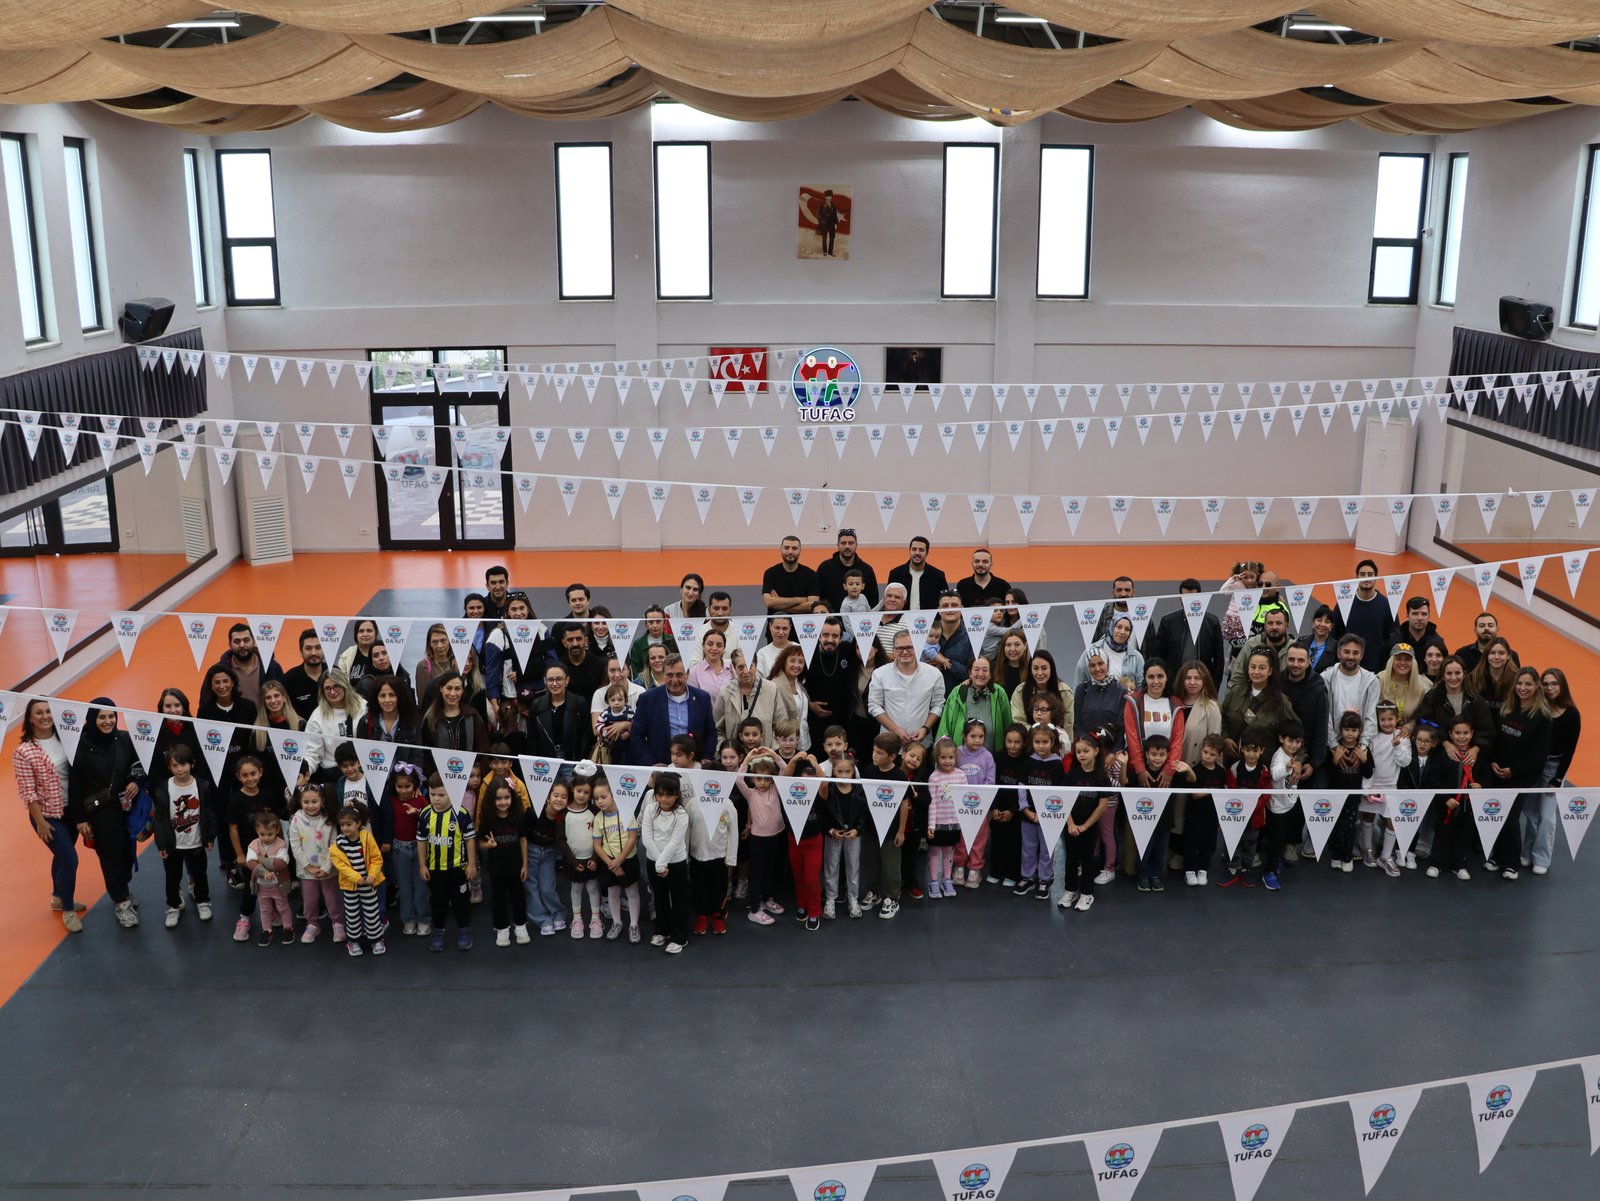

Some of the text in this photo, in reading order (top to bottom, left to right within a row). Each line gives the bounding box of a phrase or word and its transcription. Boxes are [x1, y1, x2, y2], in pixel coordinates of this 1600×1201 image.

[799, 407, 856, 422] TUFAG
[59, 725, 80, 733] TUFAG
[134, 734, 155, 743] TUFAG
[204, 744, 226, 753] TUFAG
[280, 754, 302, 762] TUFAG
[366, 764, 388, 772] TUFAG
[444, 772, 468, 780] TUFAG
[529, 774, 552, 783] TUFAG
[1478, 1108, 1514, 1122] TUFAG
[1361, 1127, 1398, 1142] TUFAG
[1234, 1148, 1273, 1163] TUFAG
[1098, 1168, 1138, 1181] TUFAG
[952, 1189, 996, 1201] TUFAG
